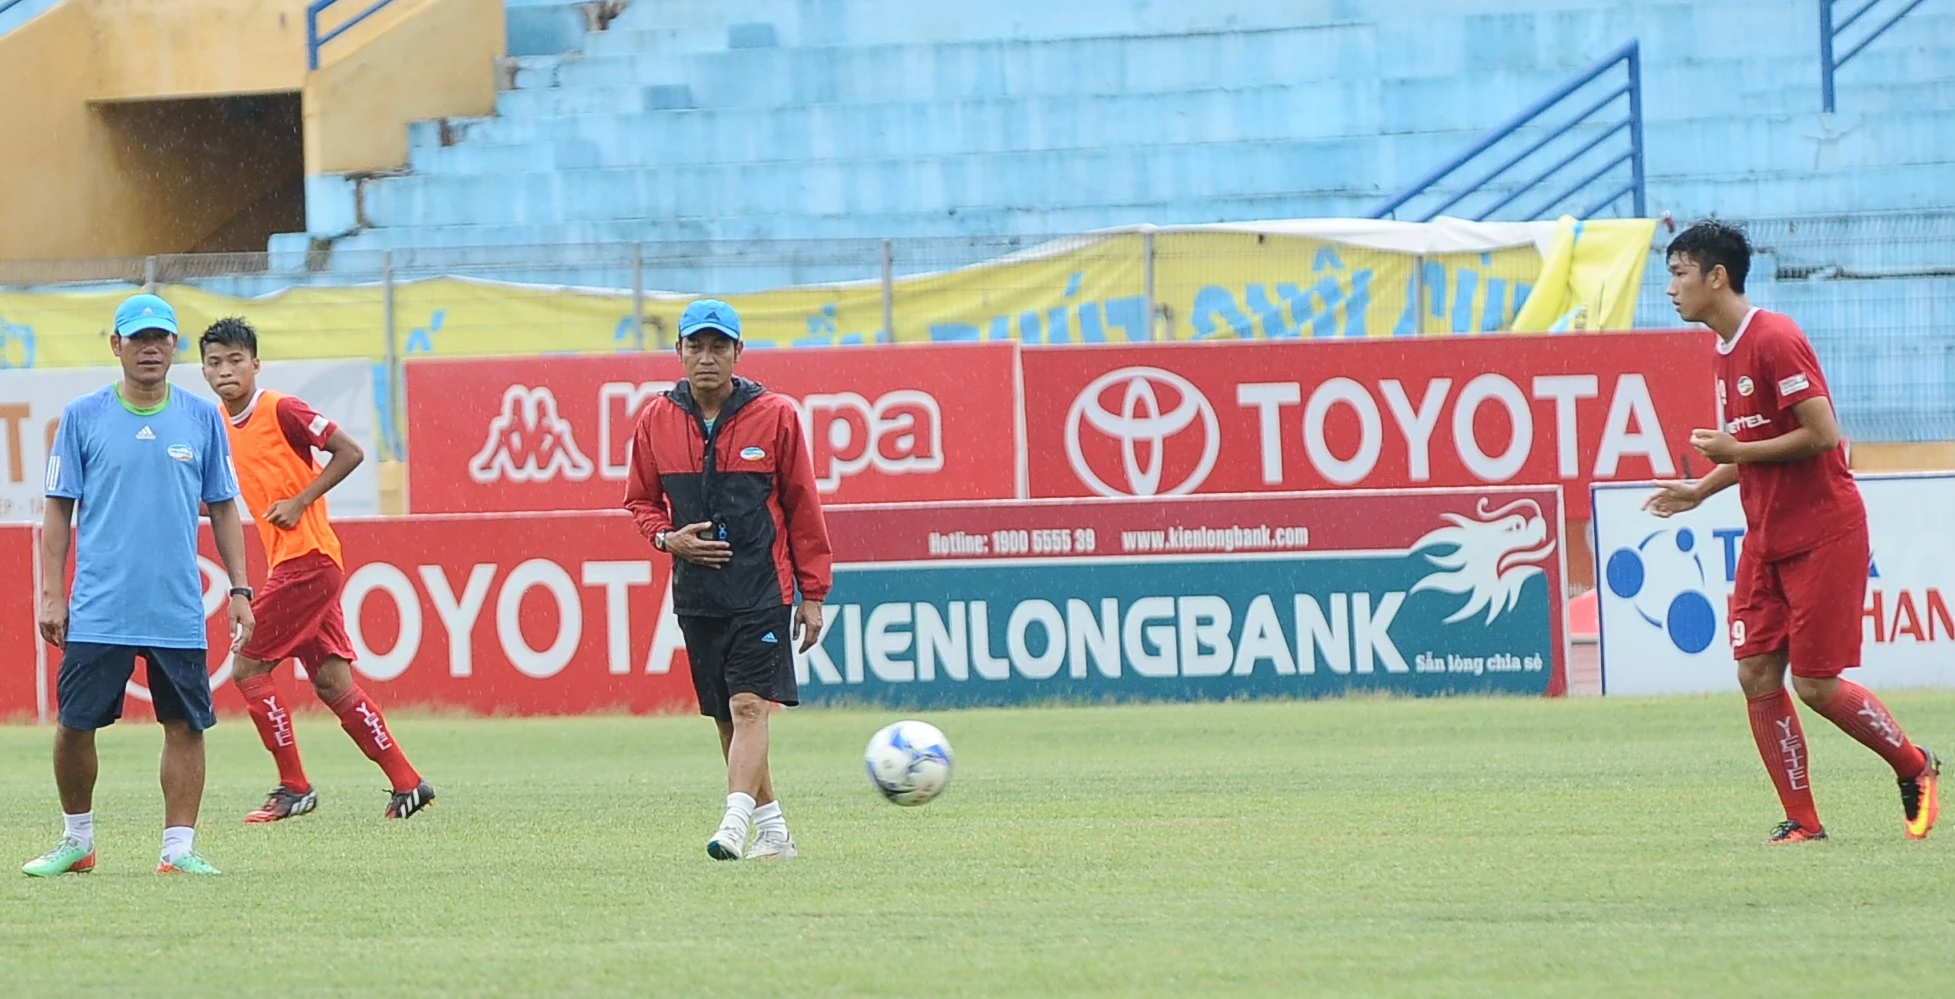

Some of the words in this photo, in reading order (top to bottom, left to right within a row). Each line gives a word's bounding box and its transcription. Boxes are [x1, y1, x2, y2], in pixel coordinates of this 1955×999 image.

[599, 381, 945, 493] Kpa
[1236, 372, 1676, 485] TOYOTA
[929, 531, 988, 556] Hotline:
[992, 530, 1029, 554] 1900
[1032, 529, 1072, 553] 5555
[1074, 528, 1096, 553] 39
[1121, 524, 1309, 552] www.kienlongbank.com
[294, 559, 688, 682] OYOT
[794, 591, 1410, 686] KIENLONGBANK
[1486, 652, 1522, 672] chia
